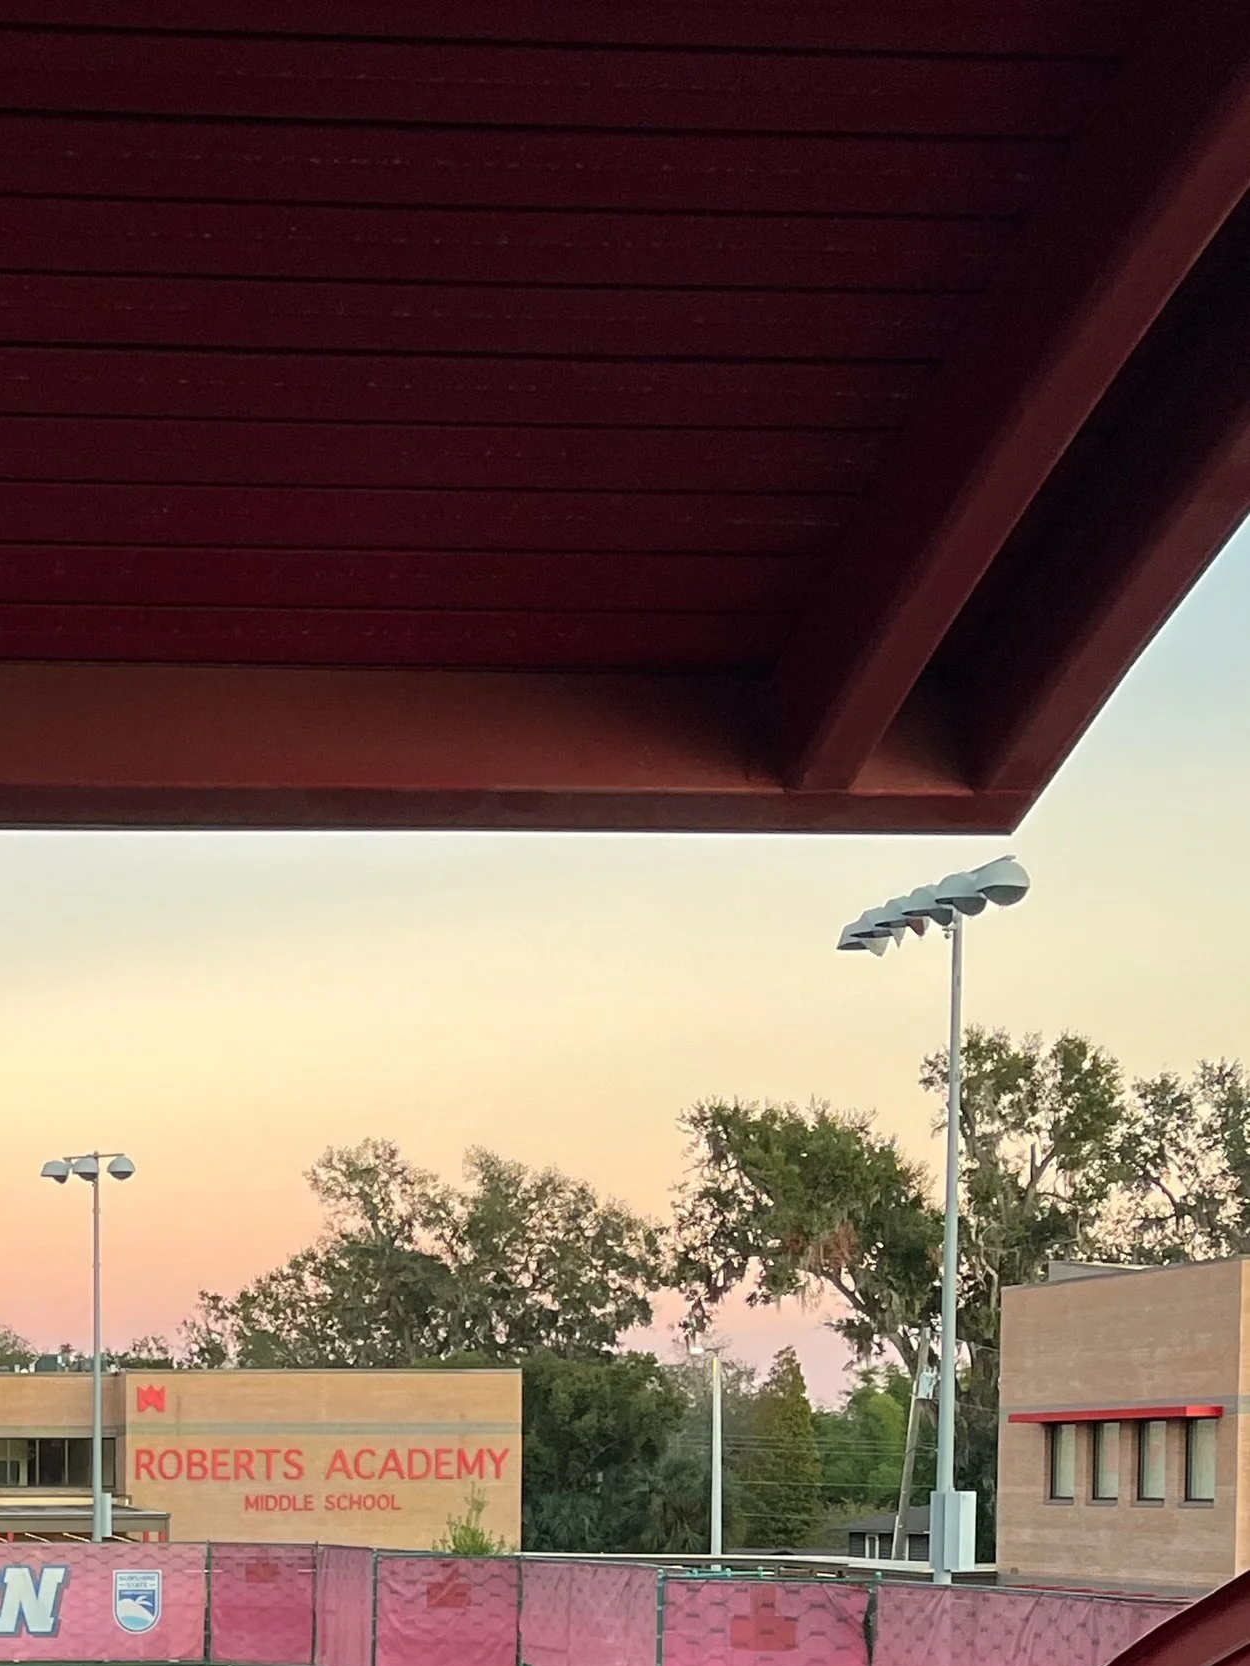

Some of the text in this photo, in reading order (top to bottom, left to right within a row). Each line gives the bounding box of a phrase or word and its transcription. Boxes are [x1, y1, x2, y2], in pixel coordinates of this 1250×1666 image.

[135, 1448, 510, 1481] ROBERTS ACADEMY
[244, 1494, 401, 1511] MIDDLE SCHOOL
